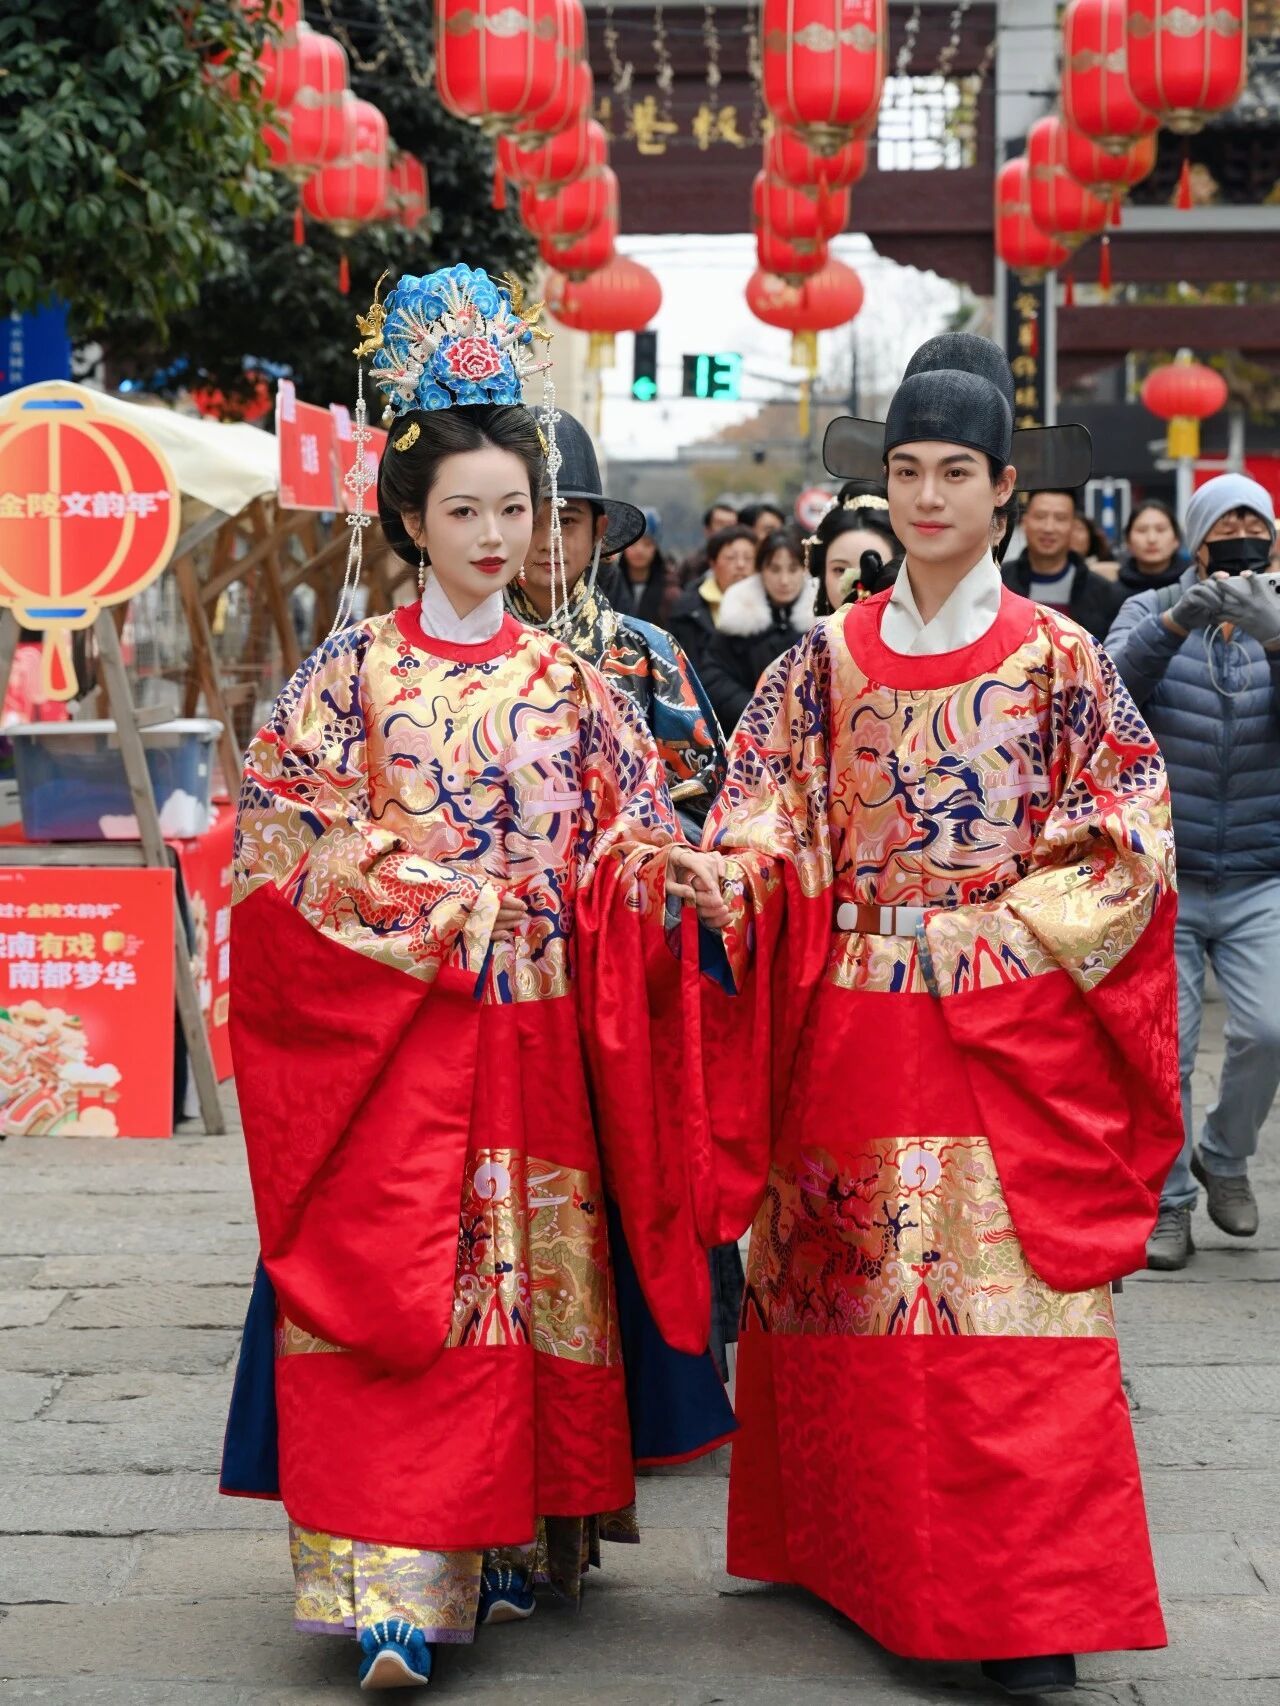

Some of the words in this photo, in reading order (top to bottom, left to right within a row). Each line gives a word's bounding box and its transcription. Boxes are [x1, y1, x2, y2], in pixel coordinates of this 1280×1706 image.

[695, 353, 742, 401] 13
[8, 960, 137, 991] 南都梦华
